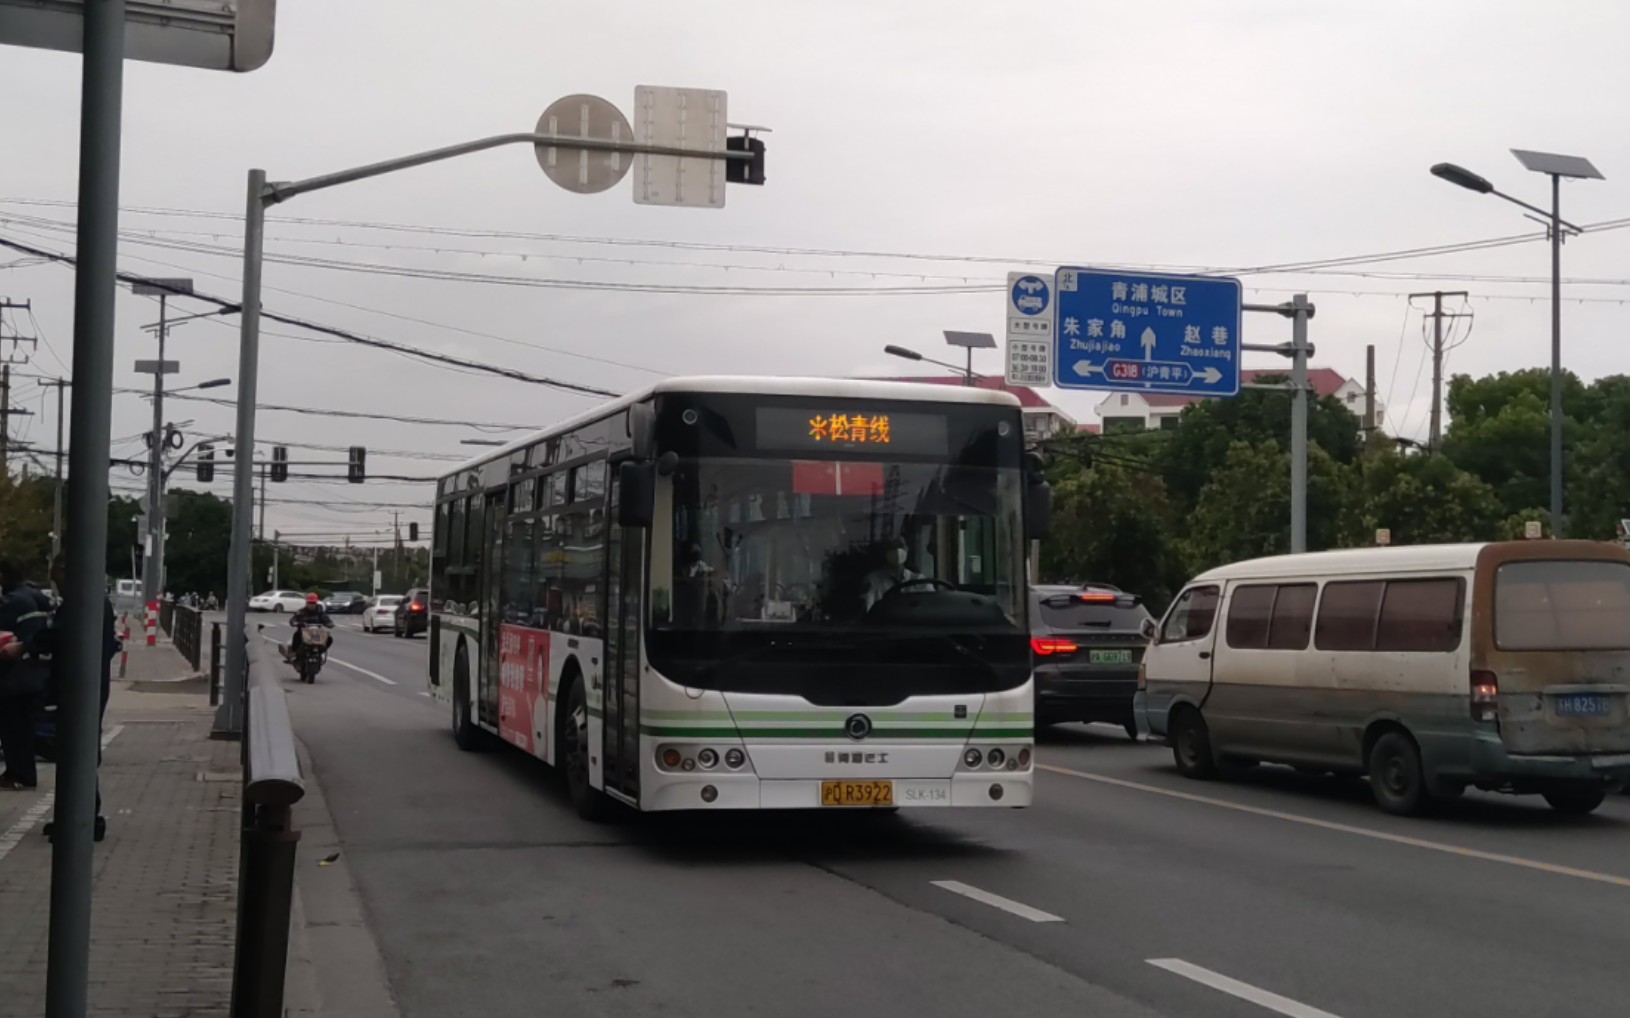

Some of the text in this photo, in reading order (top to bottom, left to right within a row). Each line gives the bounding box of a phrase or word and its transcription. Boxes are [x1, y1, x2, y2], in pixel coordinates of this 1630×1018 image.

[1063, 272, 1074, 283] 北
[1111, 281, 1187, 305] 青浦城区
[1112, 303, 1183, 318] Qingpu Town
[1063, 317, 1126, 339] 朱家角
[1184, 324, 1229, 346] 赵巷
[1070, 338, 1121, 354] Zhujiajiao
[1180, 345, 1232, 360] Zhaoxiang
[1113, 364, 1139, 378] G318
[905, 788, 947, 800] SLK-134
